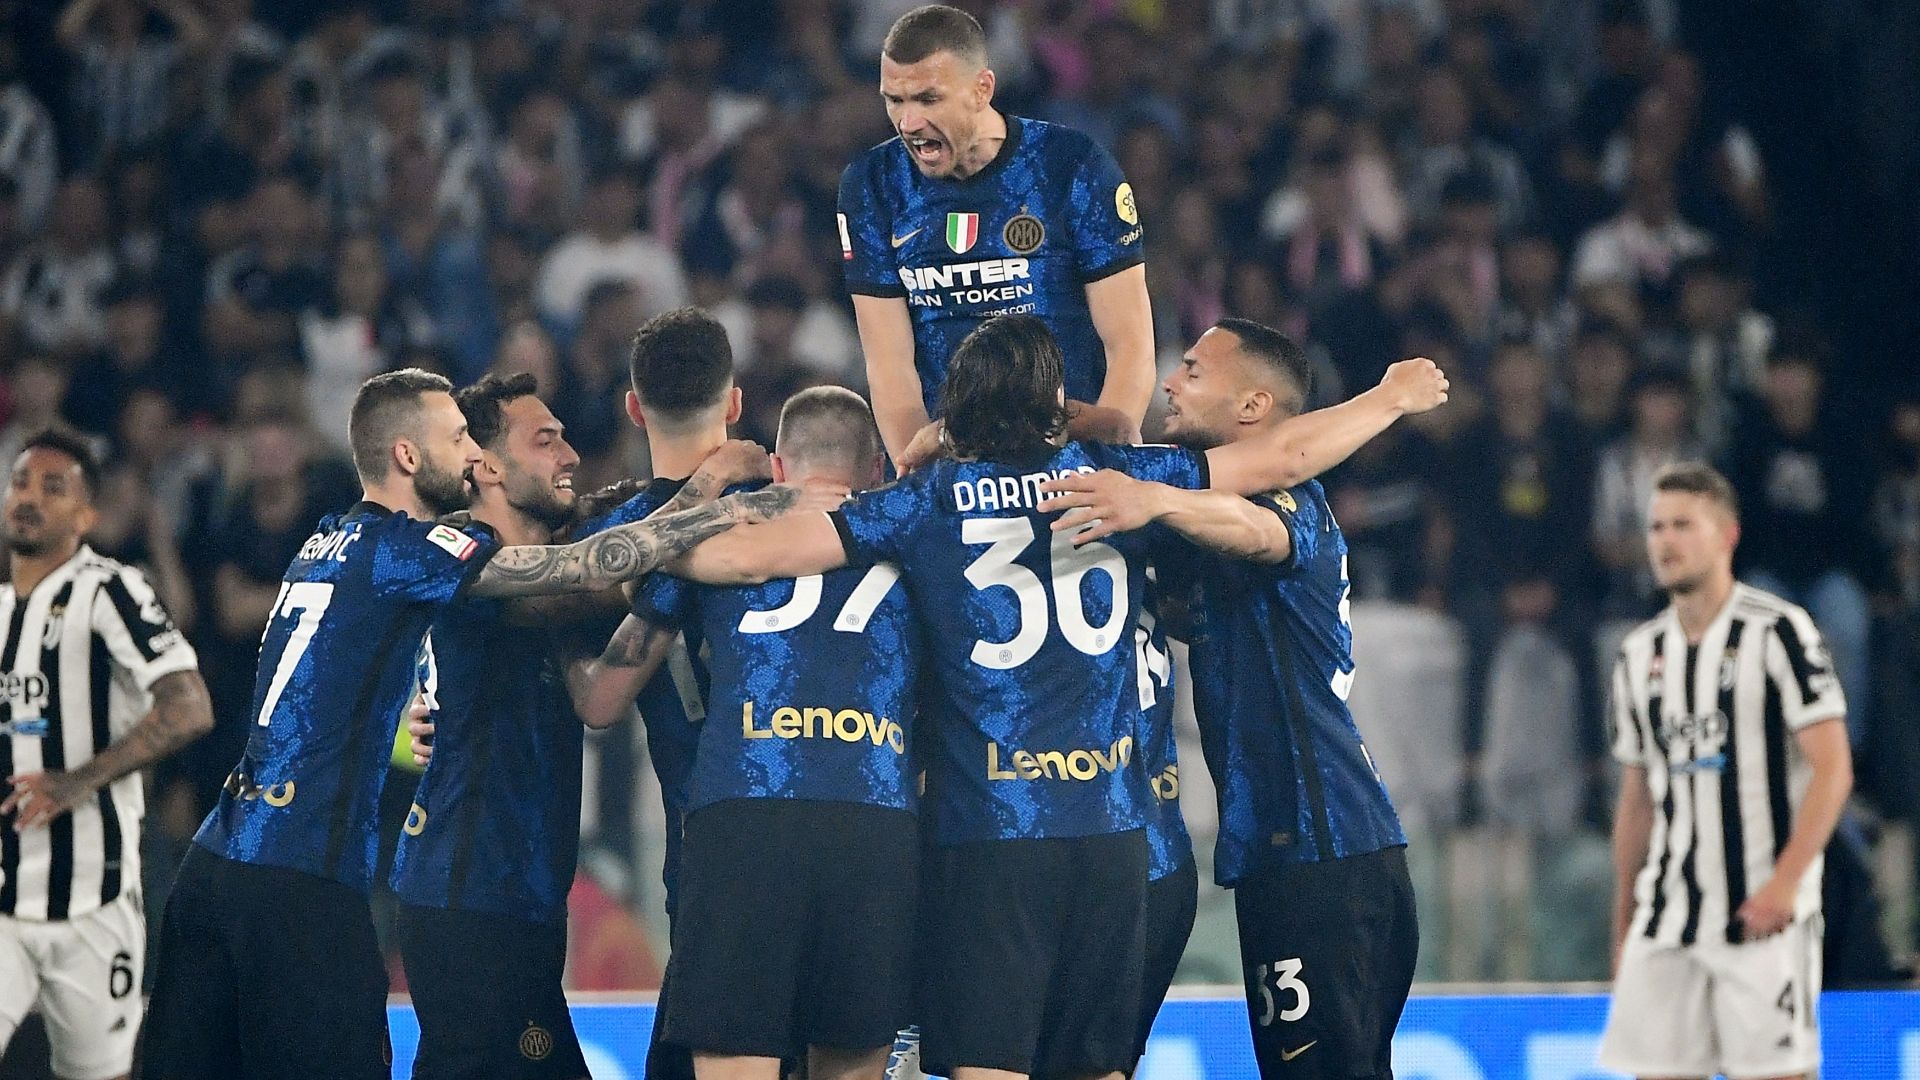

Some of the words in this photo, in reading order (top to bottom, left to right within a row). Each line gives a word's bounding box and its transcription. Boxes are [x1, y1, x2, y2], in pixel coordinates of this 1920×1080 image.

[950, 283, 1033, 304] TOKEN
[962, 516, 1128, 670] 36
[743, 701, 905, 755] Lenovo
[987, 735, 1133, 781] Lenovo
[110, 952, 133, 999] 6
